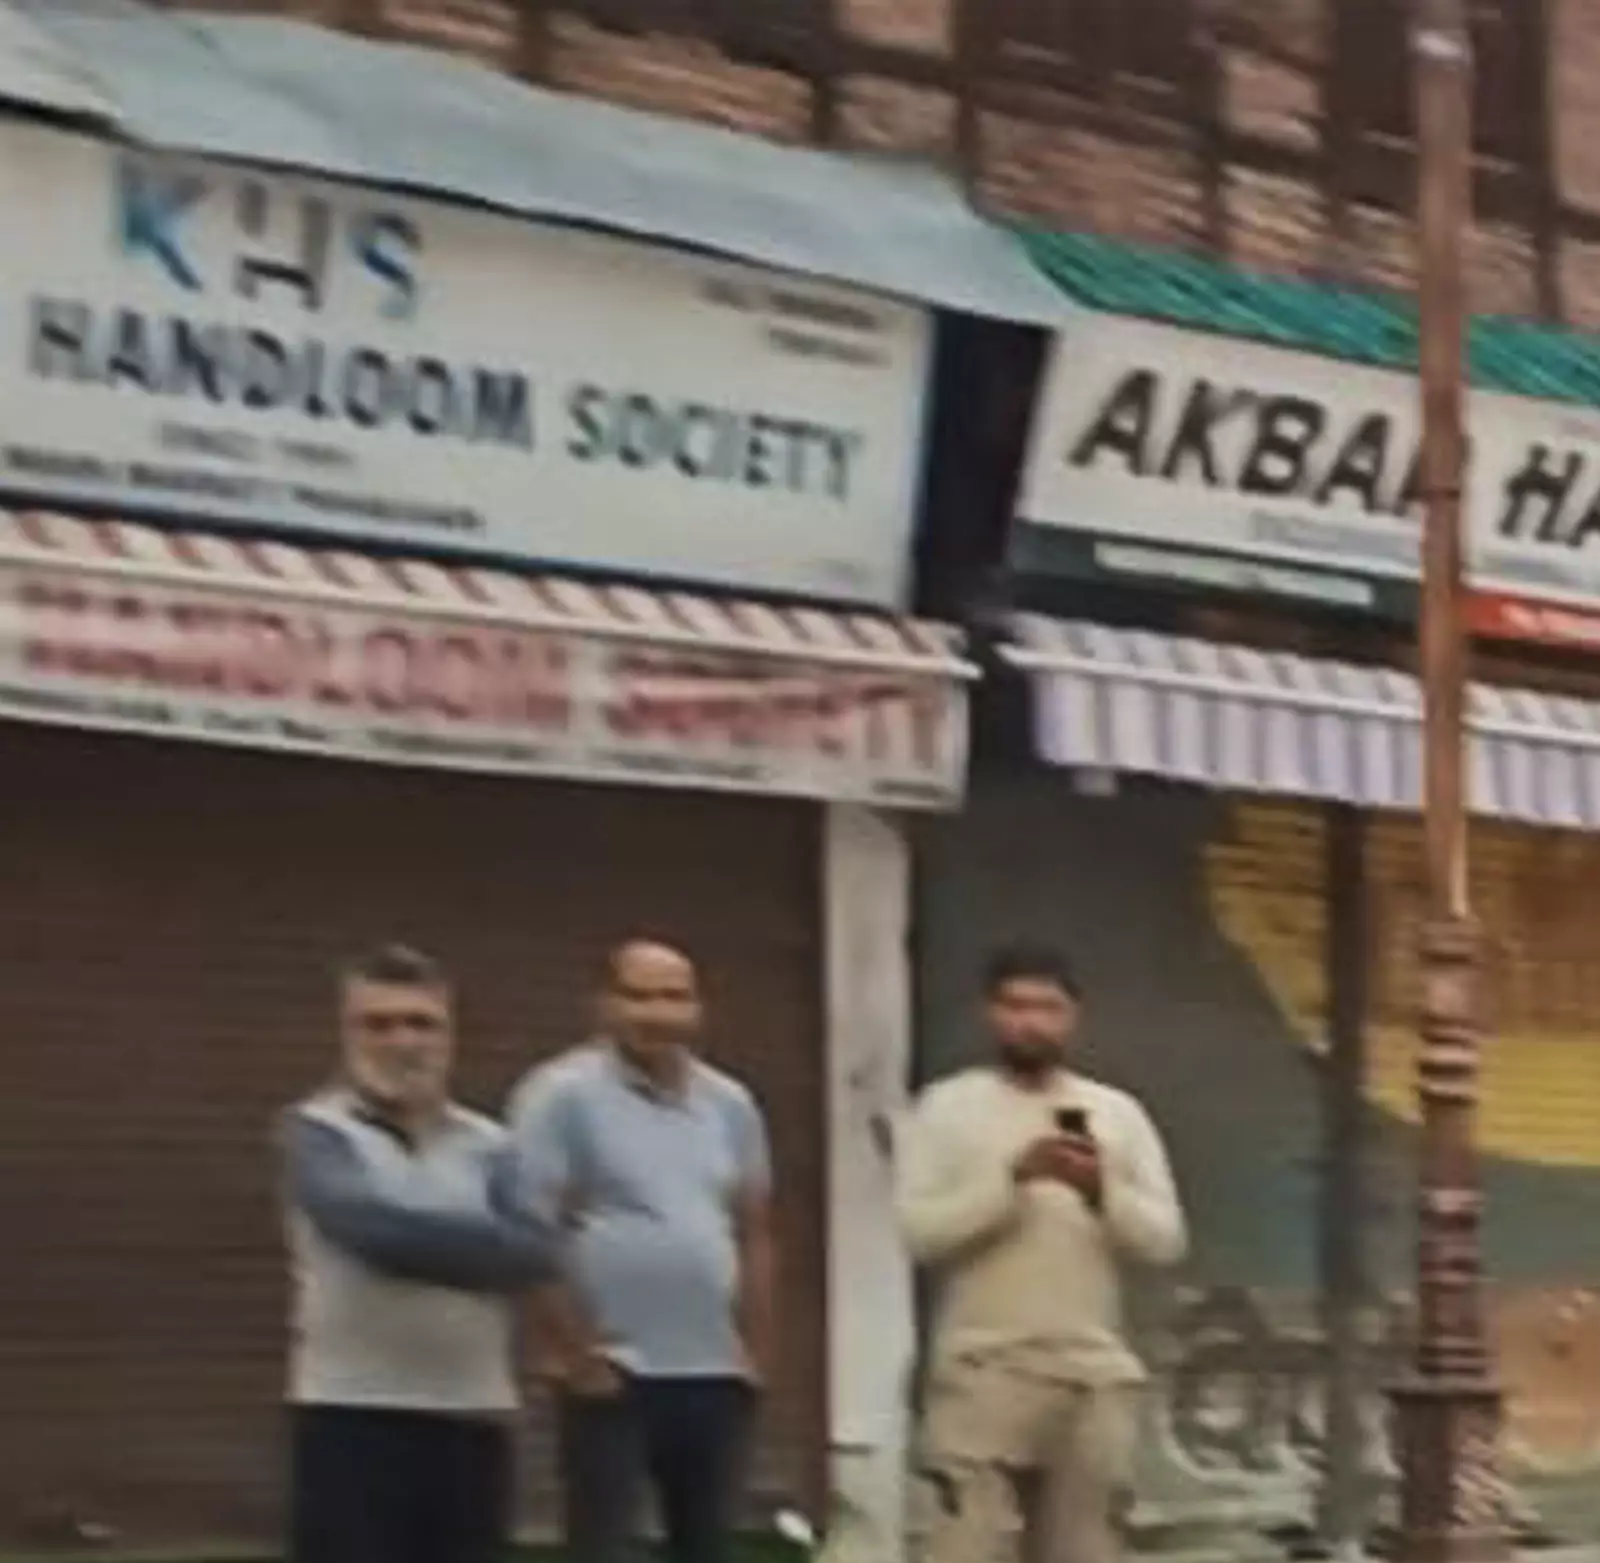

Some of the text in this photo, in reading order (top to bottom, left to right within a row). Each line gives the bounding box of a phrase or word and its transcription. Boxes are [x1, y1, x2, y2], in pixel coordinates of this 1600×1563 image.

[115, 157, 422, 320] KHS
[27, 294, 535, 452] HANDLOOM
[564, 384, 863, 500] SOCIETY
